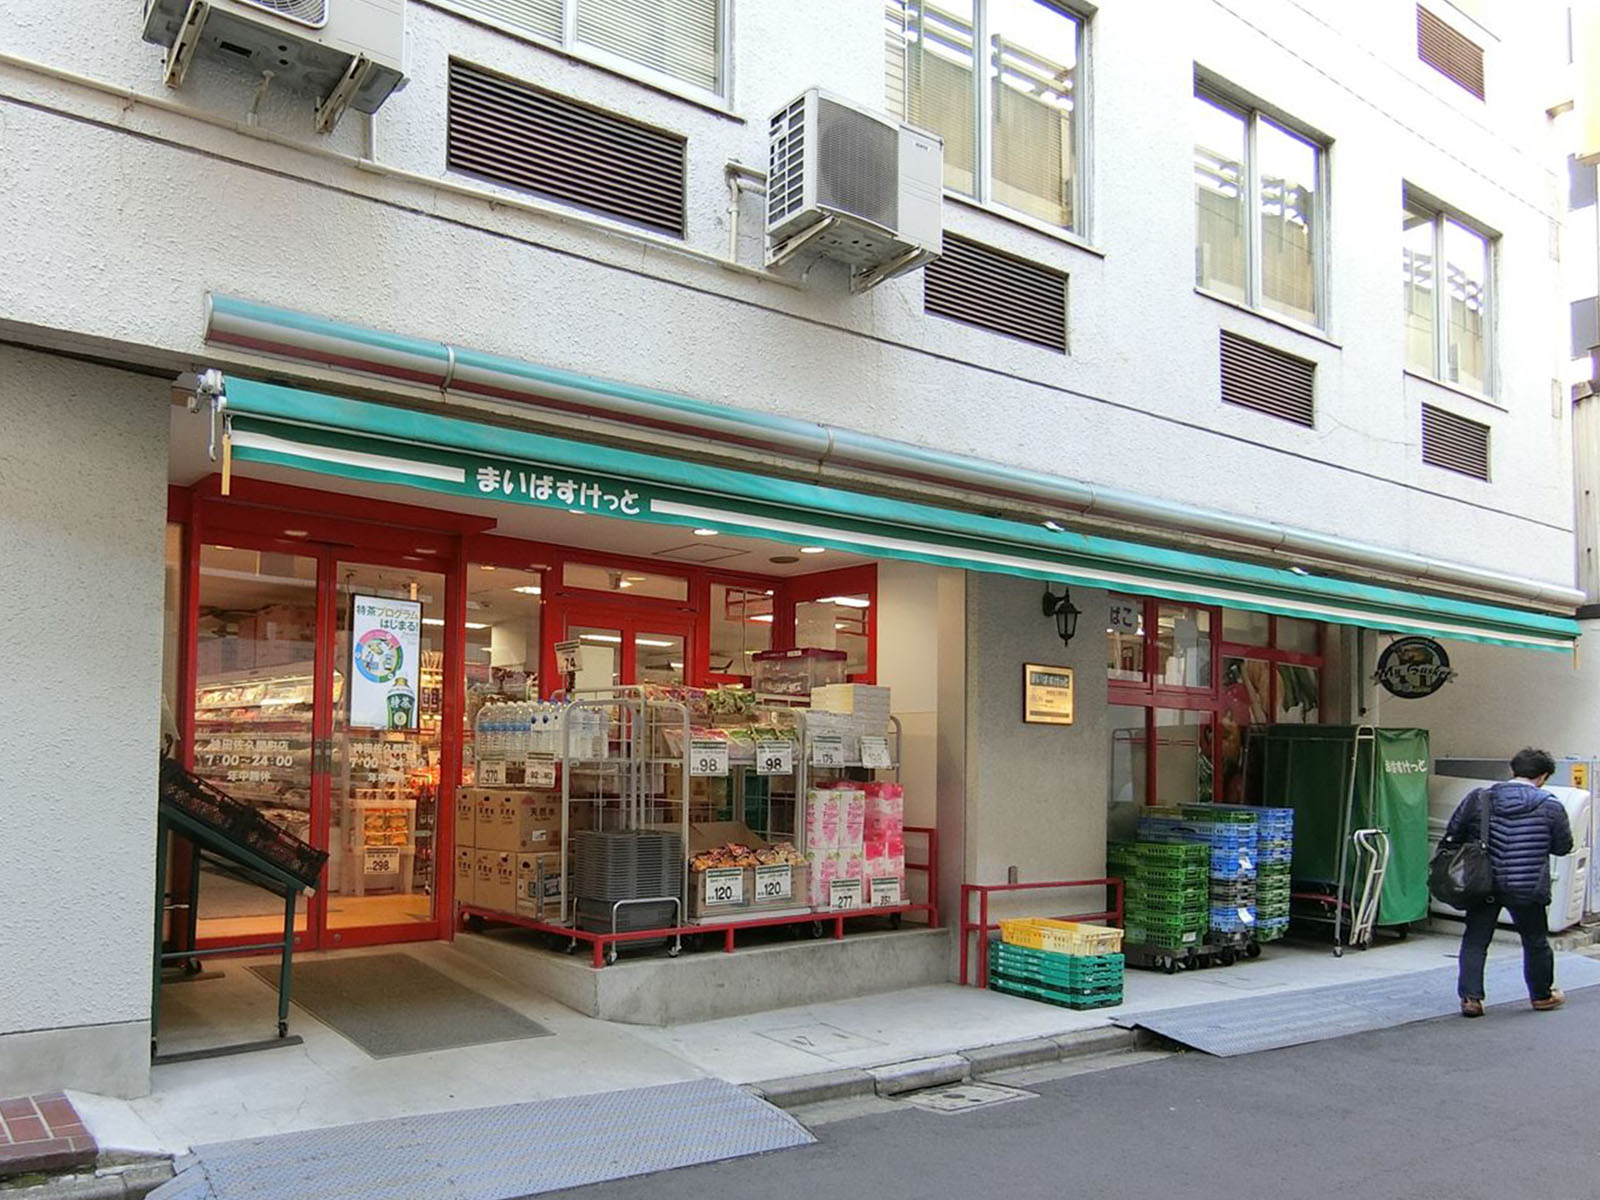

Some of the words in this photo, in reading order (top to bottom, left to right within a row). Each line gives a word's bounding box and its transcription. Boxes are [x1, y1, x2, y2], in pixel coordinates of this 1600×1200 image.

[476, 466, 640, 515] まいばすけっと
[356, 604, 418, 620] 特茶プログラム
[700, 758, 717, 772] 98
[766, 757, 782, 770] 98
[372, 859, 390, 872] 298
[714, 885, 733, 900] 120
[763, 881, 782, 896] 120
[838, 895, 853, 909] 277
